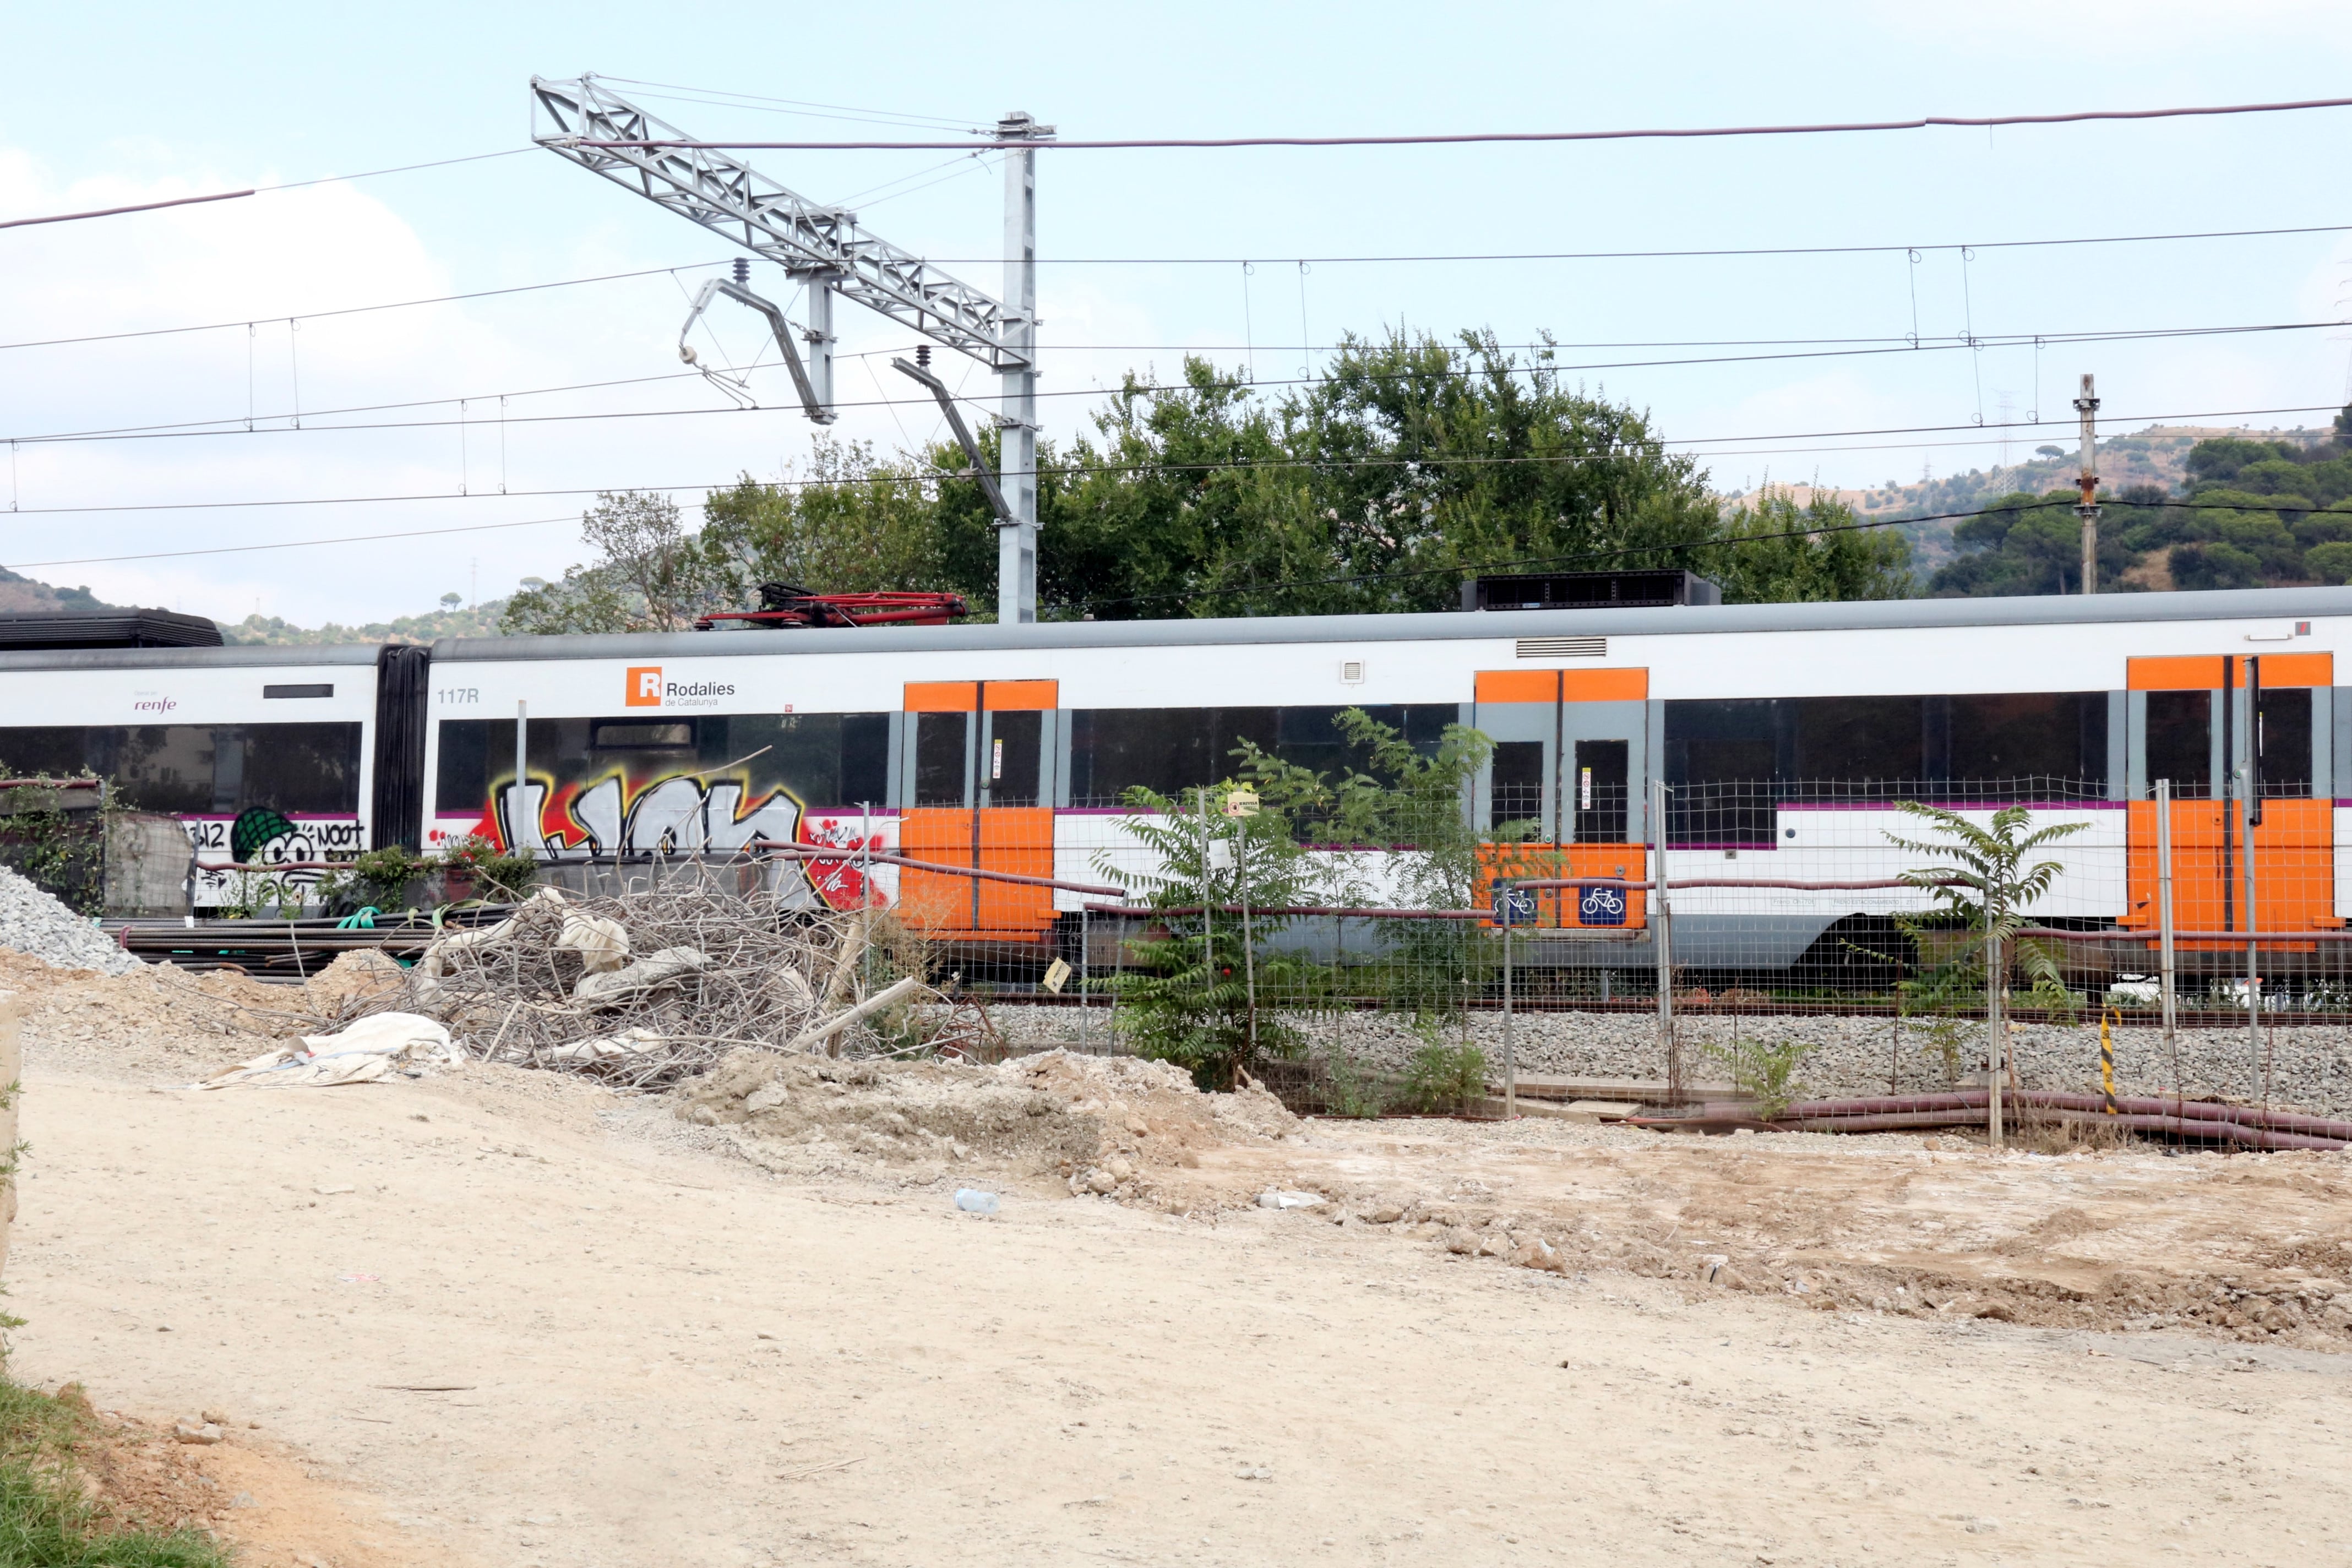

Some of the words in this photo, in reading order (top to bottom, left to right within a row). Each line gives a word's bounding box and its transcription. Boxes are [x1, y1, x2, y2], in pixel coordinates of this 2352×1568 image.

[640, 673, 660, 698] R
[667, 682, 735, 696] Rodalies
[438, 688, 478, 703] 117R
[678, 697, 718, 707] Catalunya
[134, 696, 177, 715] renfe
